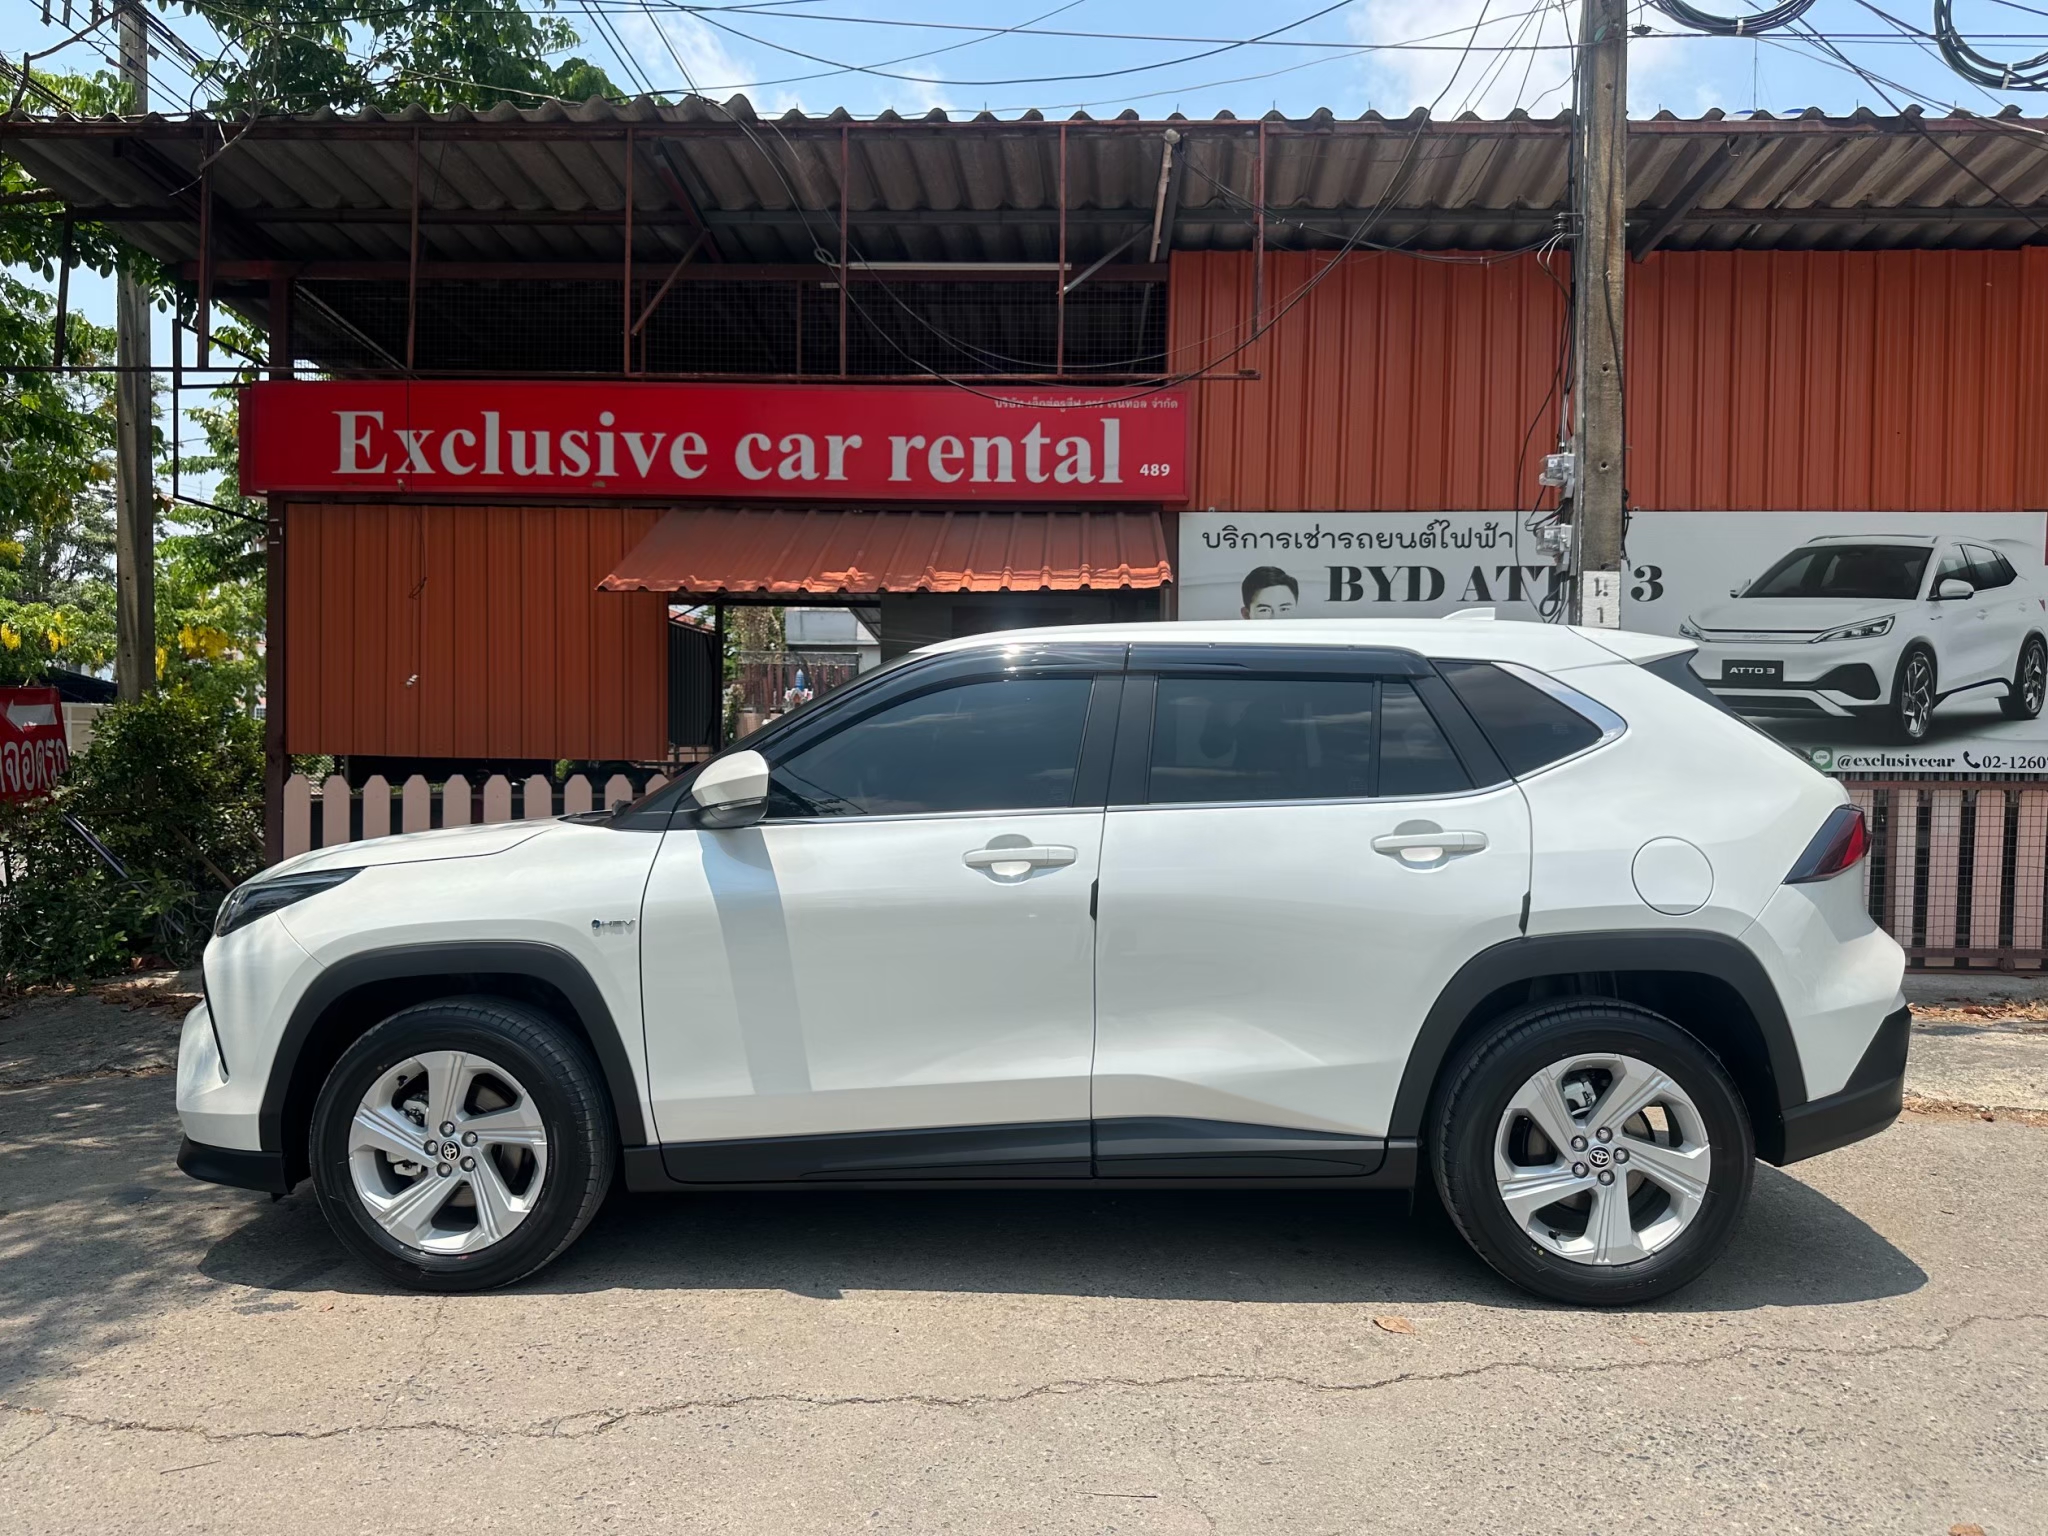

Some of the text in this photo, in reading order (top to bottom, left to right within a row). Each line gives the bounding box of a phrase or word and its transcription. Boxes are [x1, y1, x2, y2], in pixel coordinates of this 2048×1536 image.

[1152, 397, 1178, 408] จำกัด
[332, 409, 1171, 485] Exclusive car rental 489
[1202, 519, 1514, 550] บริการเช่ารถยนต์ไฟฟ้า
[1325, 564, 1665, 602] BYD ATT 3
[1729, 666, 1763, 674] ATTO
[1837, 753, 1956, 769] @exclusivecar
[1982, 755, 2048, 769] 02-1260
